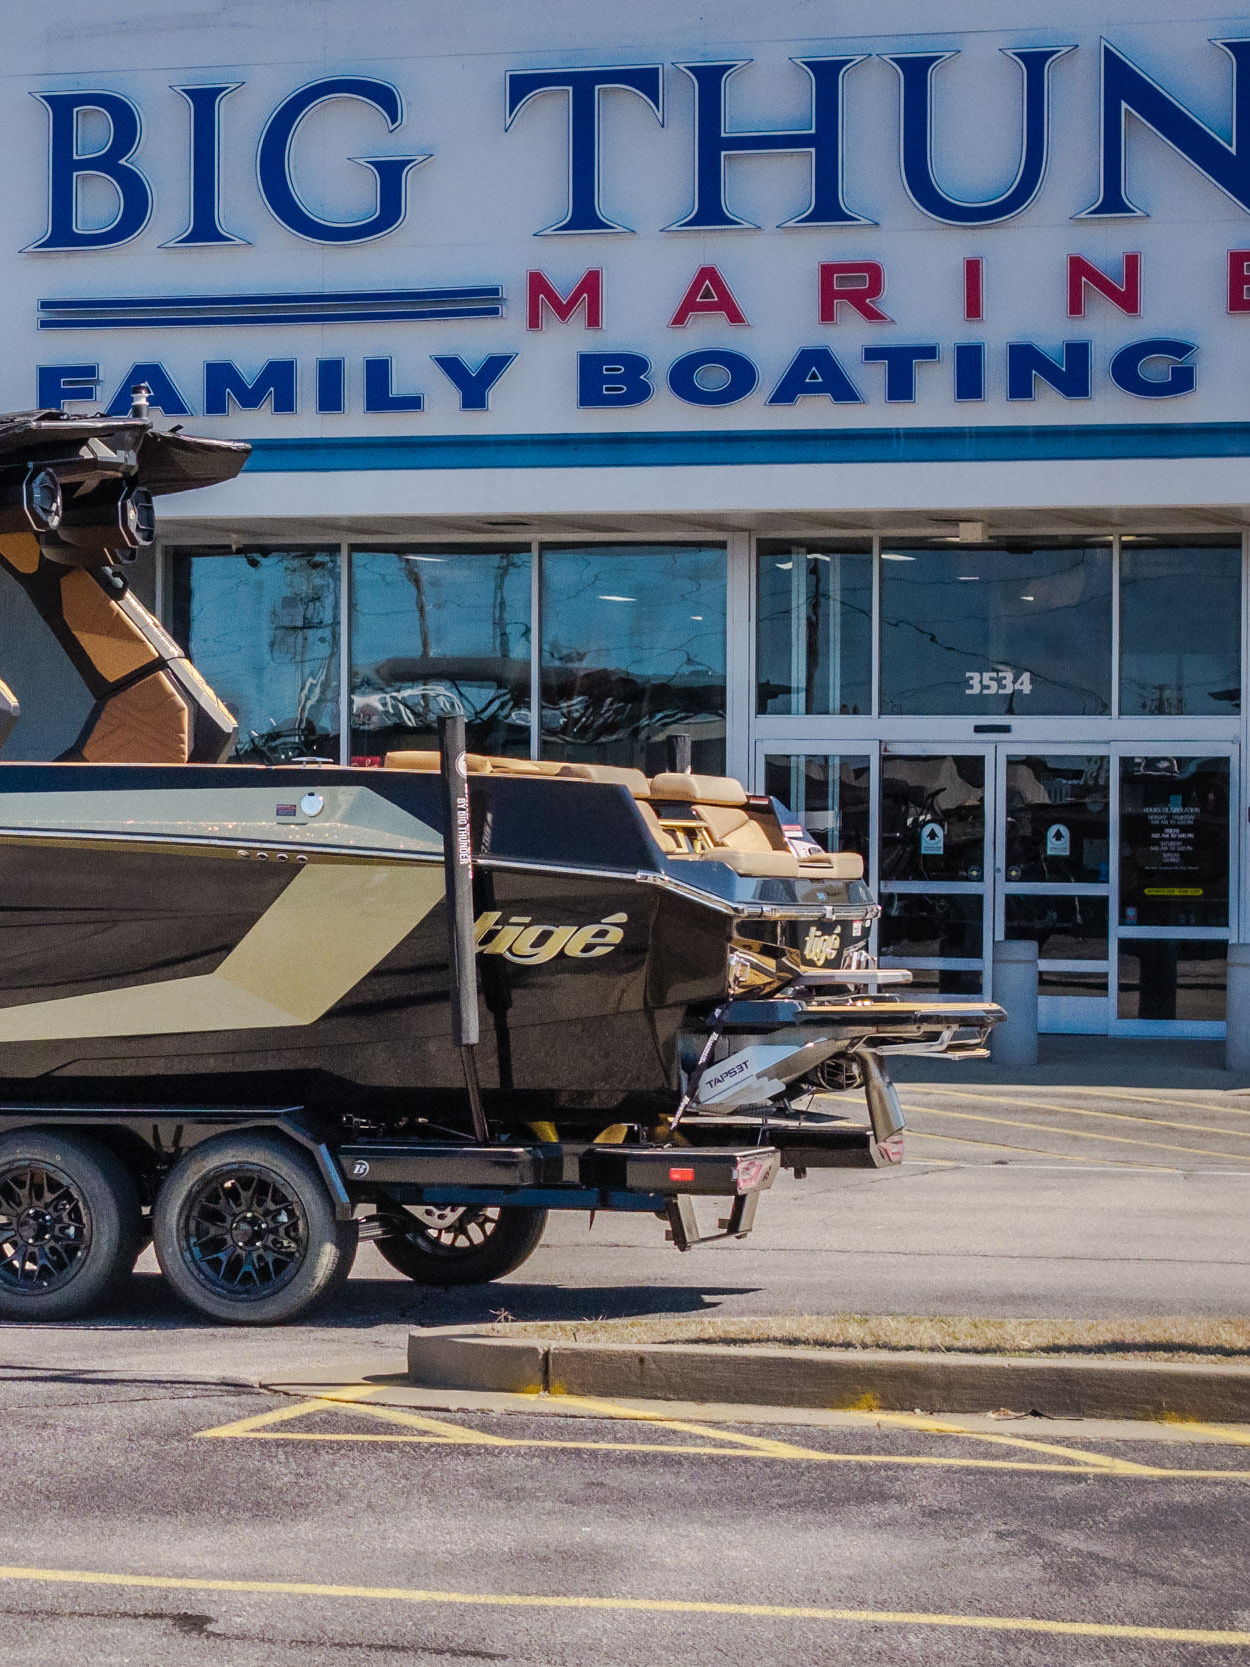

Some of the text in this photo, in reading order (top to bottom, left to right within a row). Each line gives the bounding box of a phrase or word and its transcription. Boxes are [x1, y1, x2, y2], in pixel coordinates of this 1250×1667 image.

[18, 36, 1250, 253] BIG THUN
[36, 337, 1200, 416] FAMILY BOATING
[965, 672, 1033, 694] 3534
[457, 797, 469, 865] BY BIG THUNDER
